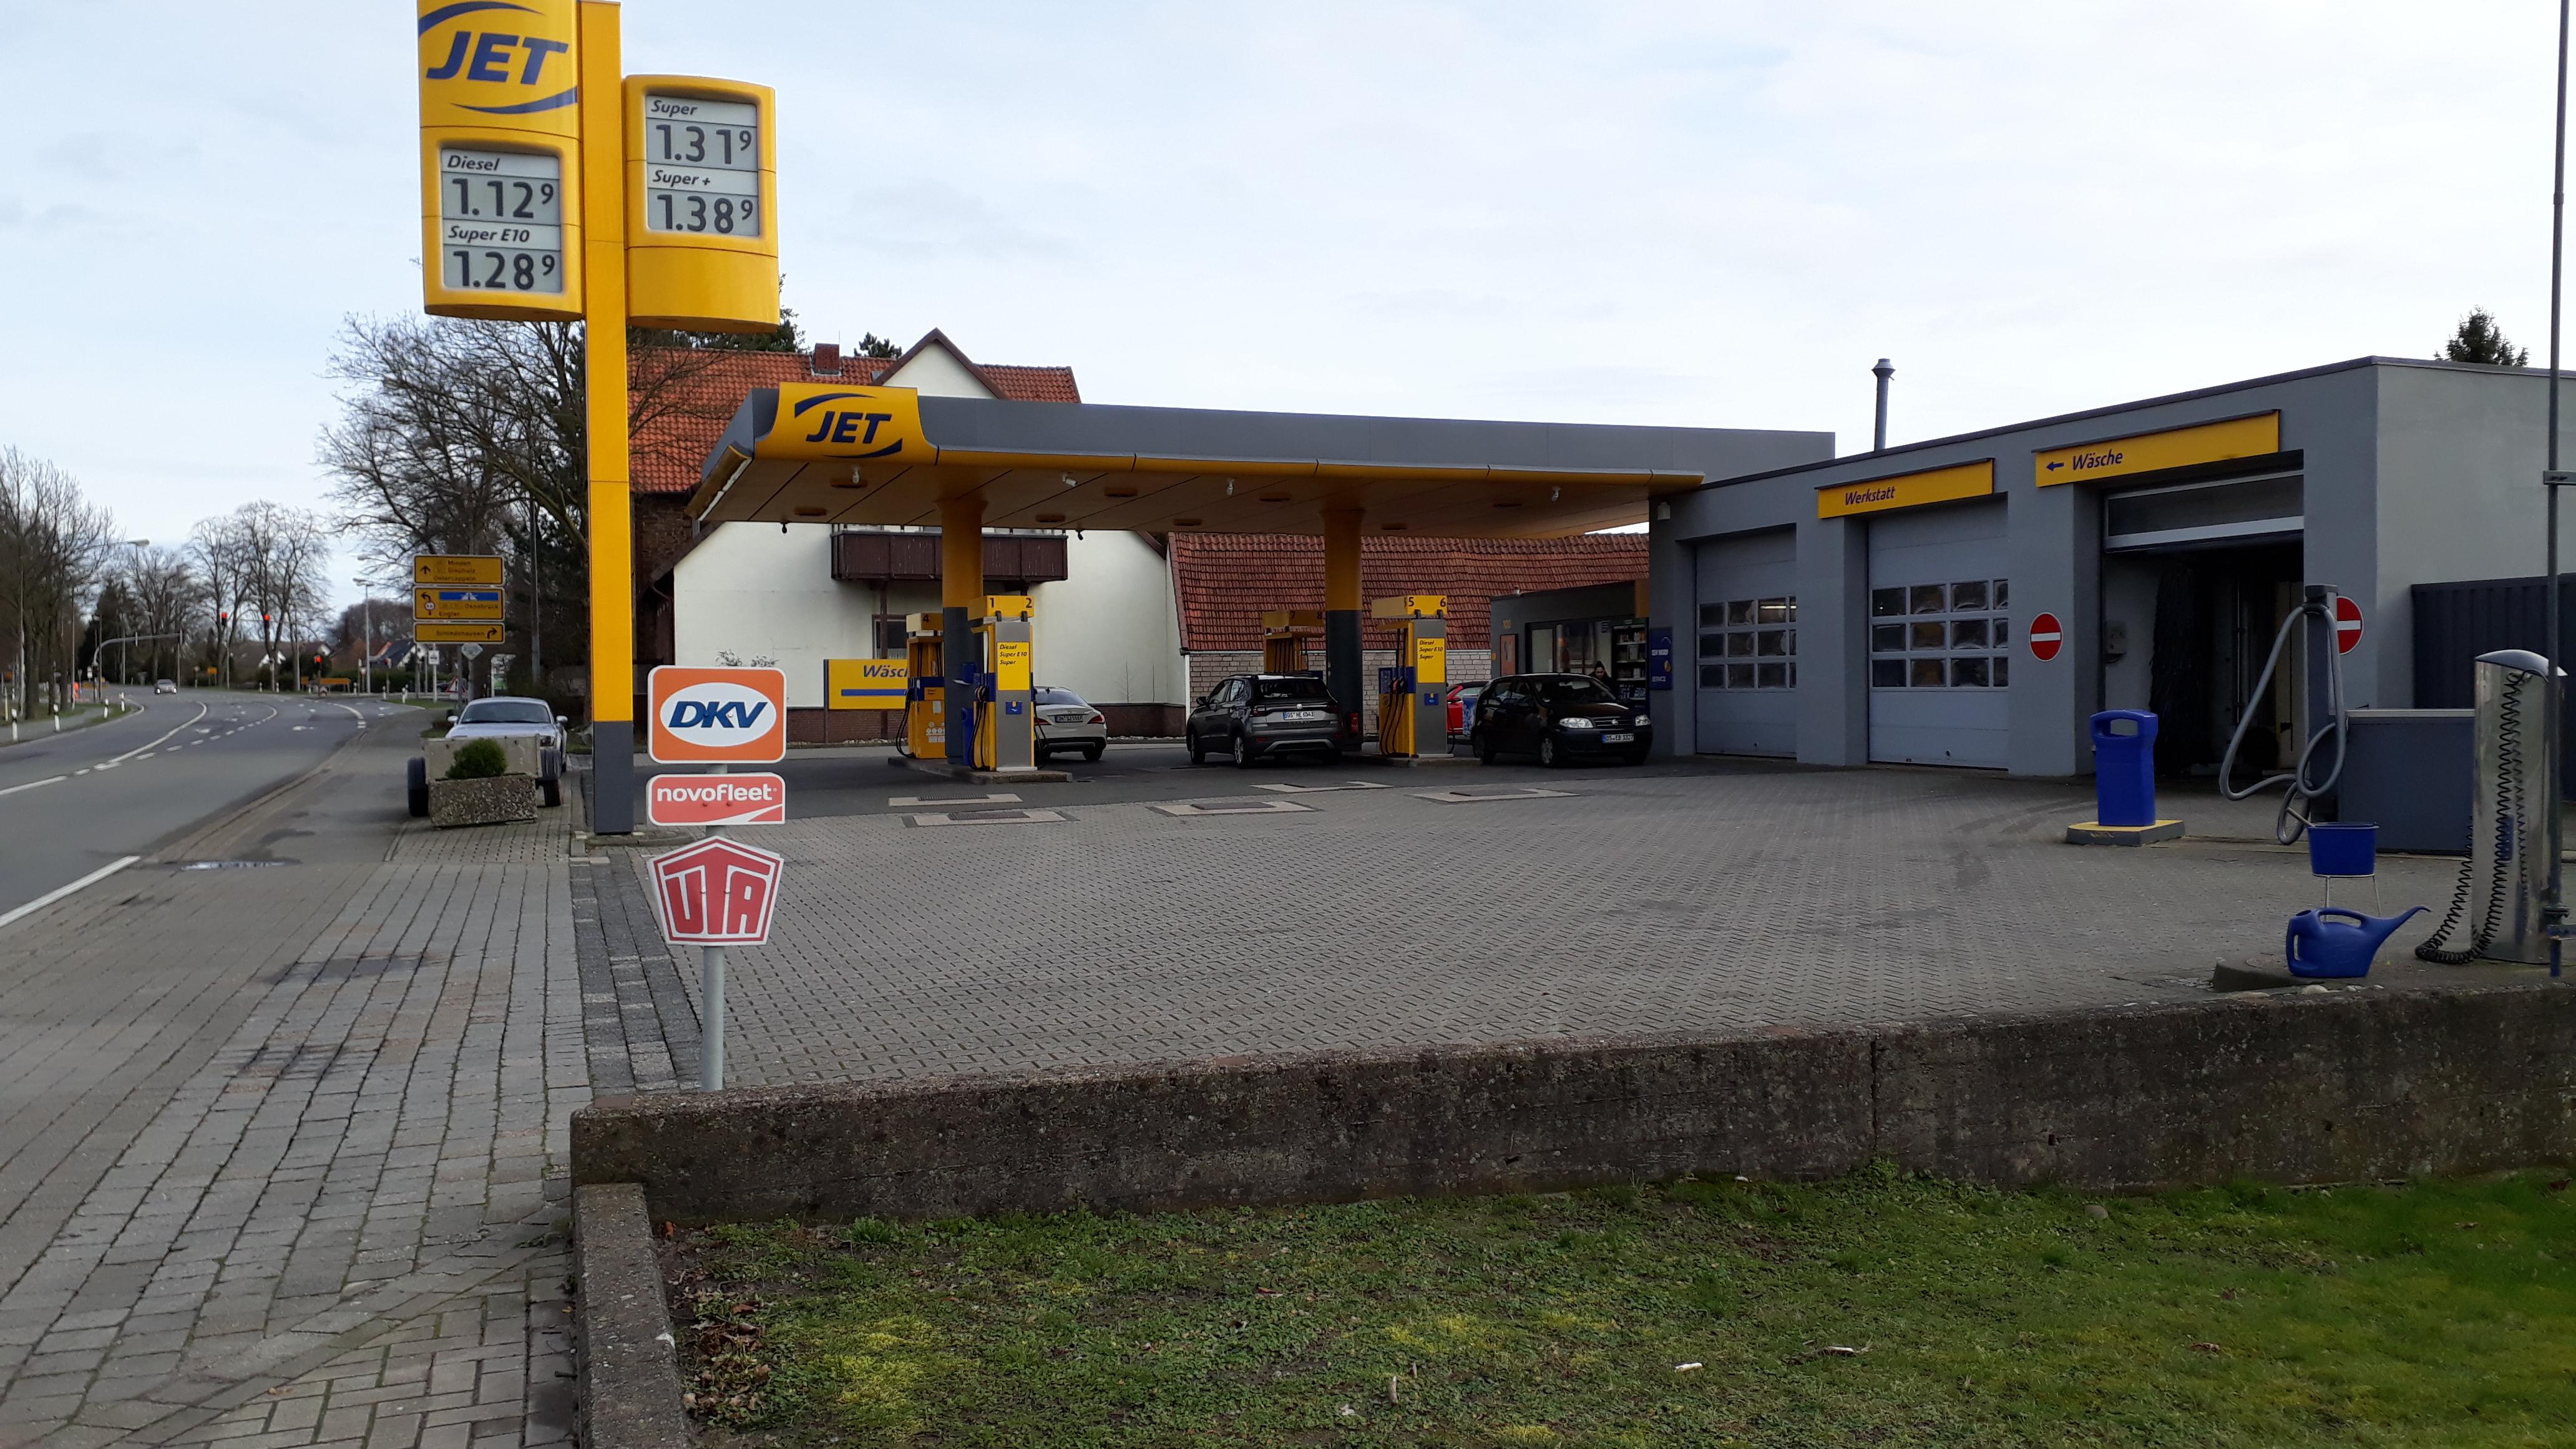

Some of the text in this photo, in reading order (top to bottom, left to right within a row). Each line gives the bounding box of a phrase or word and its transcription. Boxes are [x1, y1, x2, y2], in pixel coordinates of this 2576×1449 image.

[426, 31, 568, 86] JET
[651, 99, 698, 117] Super
[447, 155, 500, 172] Diesel
[653, 170, 700, 188] Super
[448, 225, 530, 243] Super E10
[805, 411, 892, 444] JET
[2072, 449, 2123, 471] Wäsche
[1845, 486, 1896, 505] Werkstatt
[990, 597, 995, 608] 1
[1025, 597, 1033, 608] 2
[1408, 597, 1415, 607] 5
[1440, 598, 1447, 607] 6
[923, 614, 930, 623] 4
[1317, 612, 1323, 620] 8
[668, 701, 768, 728] DKV
[657, 783, 773, 802] novofleet
[662, 846, 771, 935] UTA
